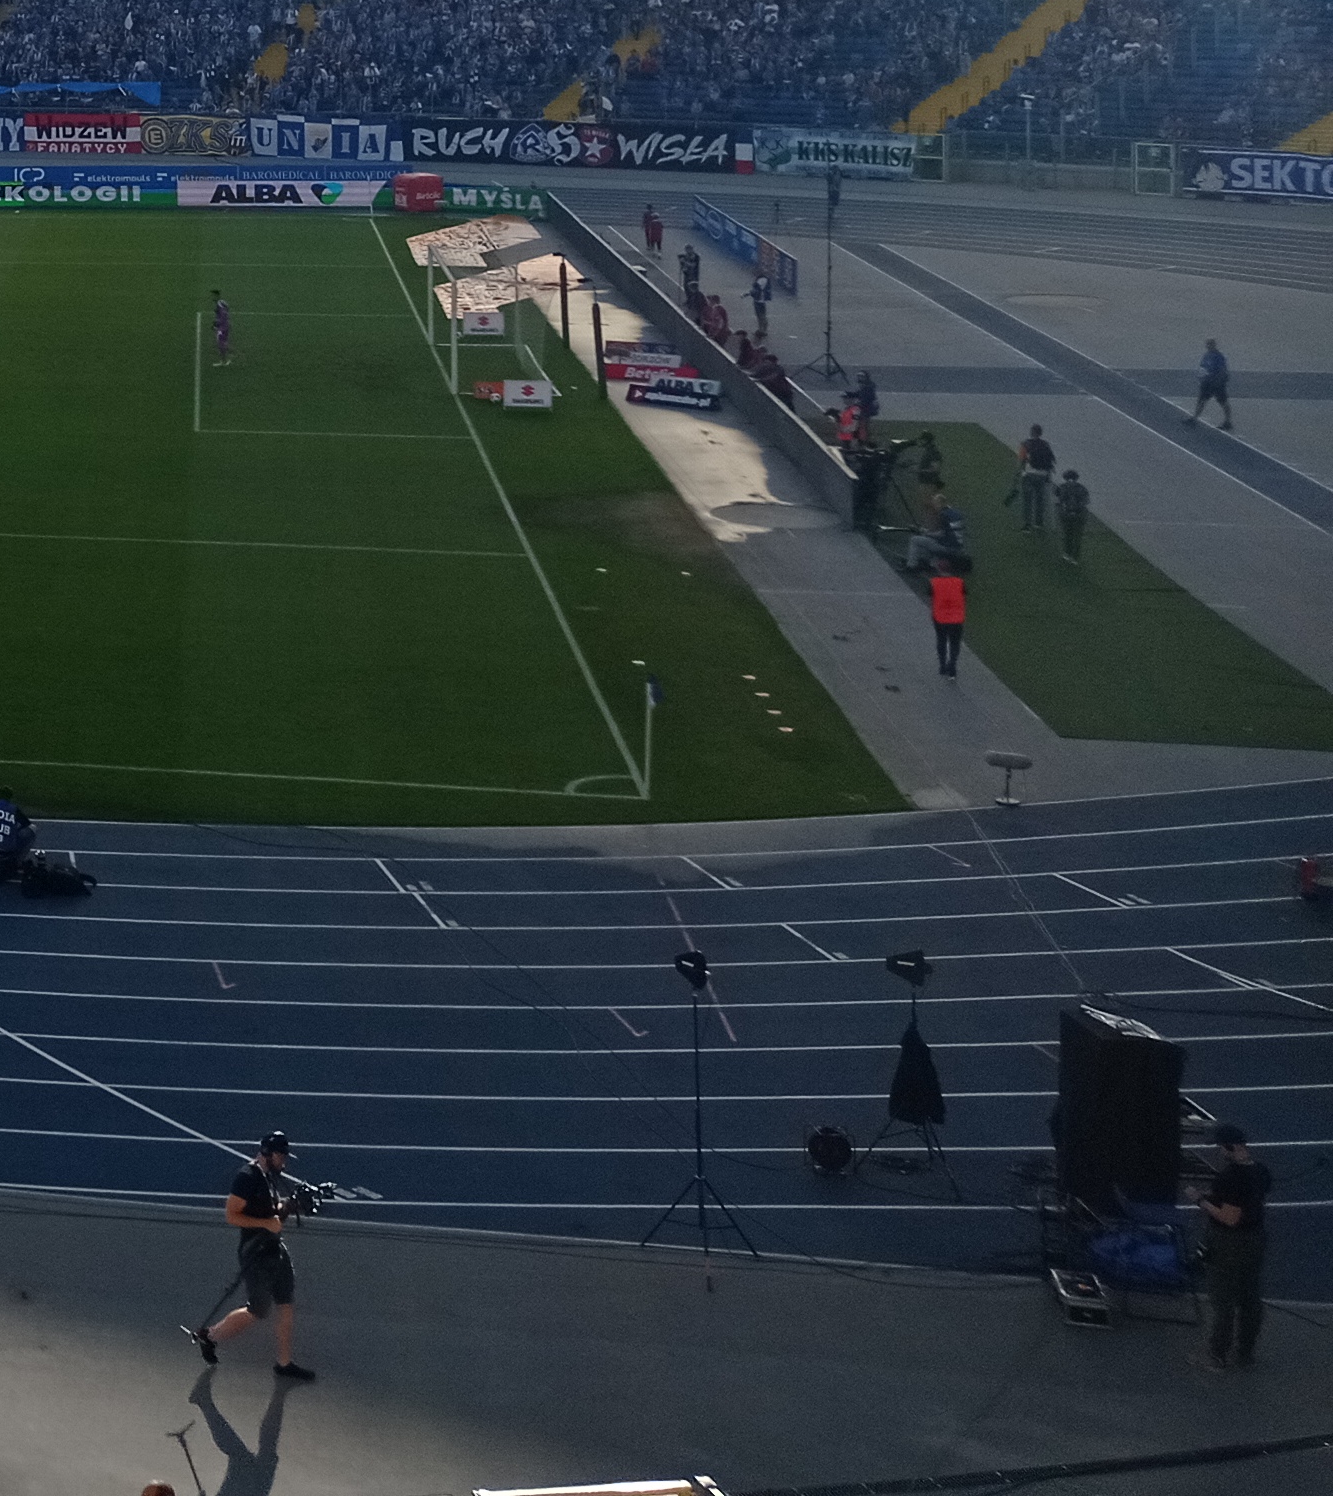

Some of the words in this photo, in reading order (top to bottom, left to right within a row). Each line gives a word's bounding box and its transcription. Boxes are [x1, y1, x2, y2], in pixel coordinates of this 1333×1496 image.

[36, 116, 128, 141] WIDZEW
[38, 142, 127, 154] FANATYCY
[413, 126, 510, 157] RUCH
[617, 131, 729, 165] WISŁA
[843, 143, 912, 168] KALISZ
[243, 170, 322, 180] BAROMEDICAL
[210, 184, 303, 203] ALBA
